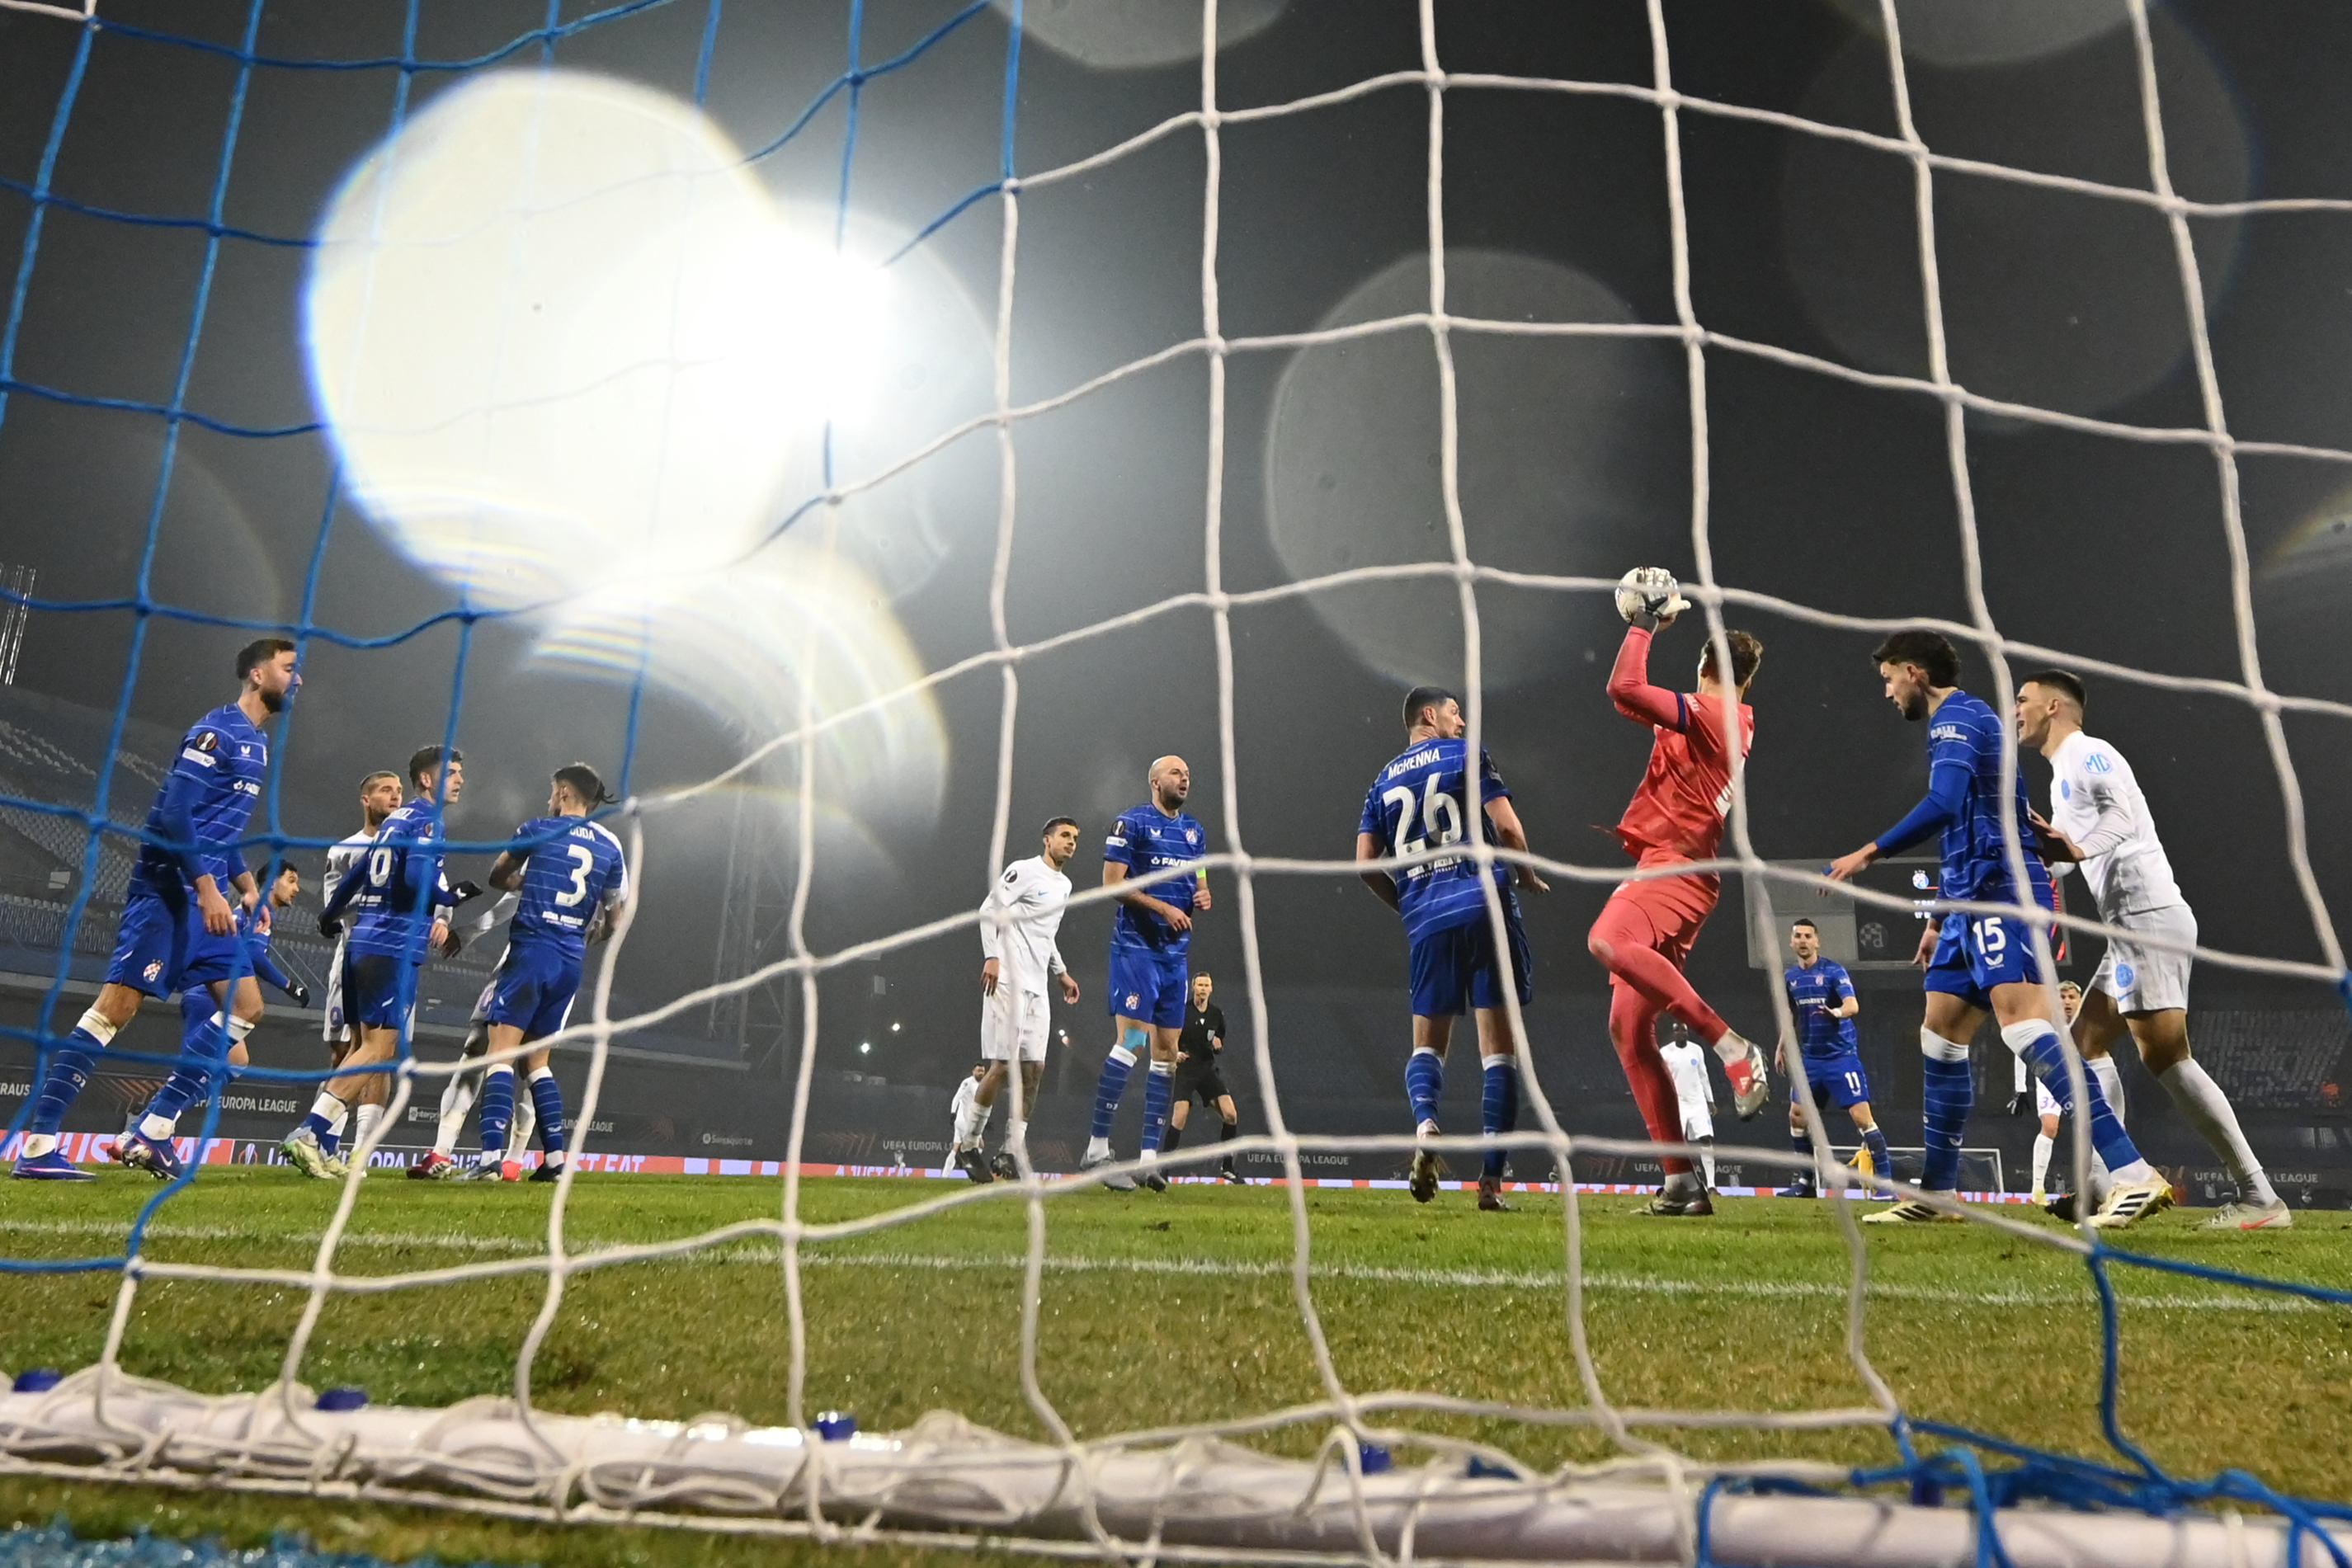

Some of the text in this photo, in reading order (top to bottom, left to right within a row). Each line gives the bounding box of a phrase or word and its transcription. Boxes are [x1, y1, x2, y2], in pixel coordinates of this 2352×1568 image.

[1382, 771, 1463, 860] 26
[554, 843, 593, 907] 3
[1973, 916, 2007, 955] 15
[1845, 1071, 1861, 1090] 11
[217, 1095, 257, 1111] EUROPA
[258, 1098, 298, 1113] LEAGUE
[908, 1141, 942, 1151] EUROPA
[1247, 1154, 1349, 1165] UEFA EUPA LEAGUE
[1634, 1163, 1660, 1173] UEFA
[2274, 1173, 2319, 1184] LEAGUE
